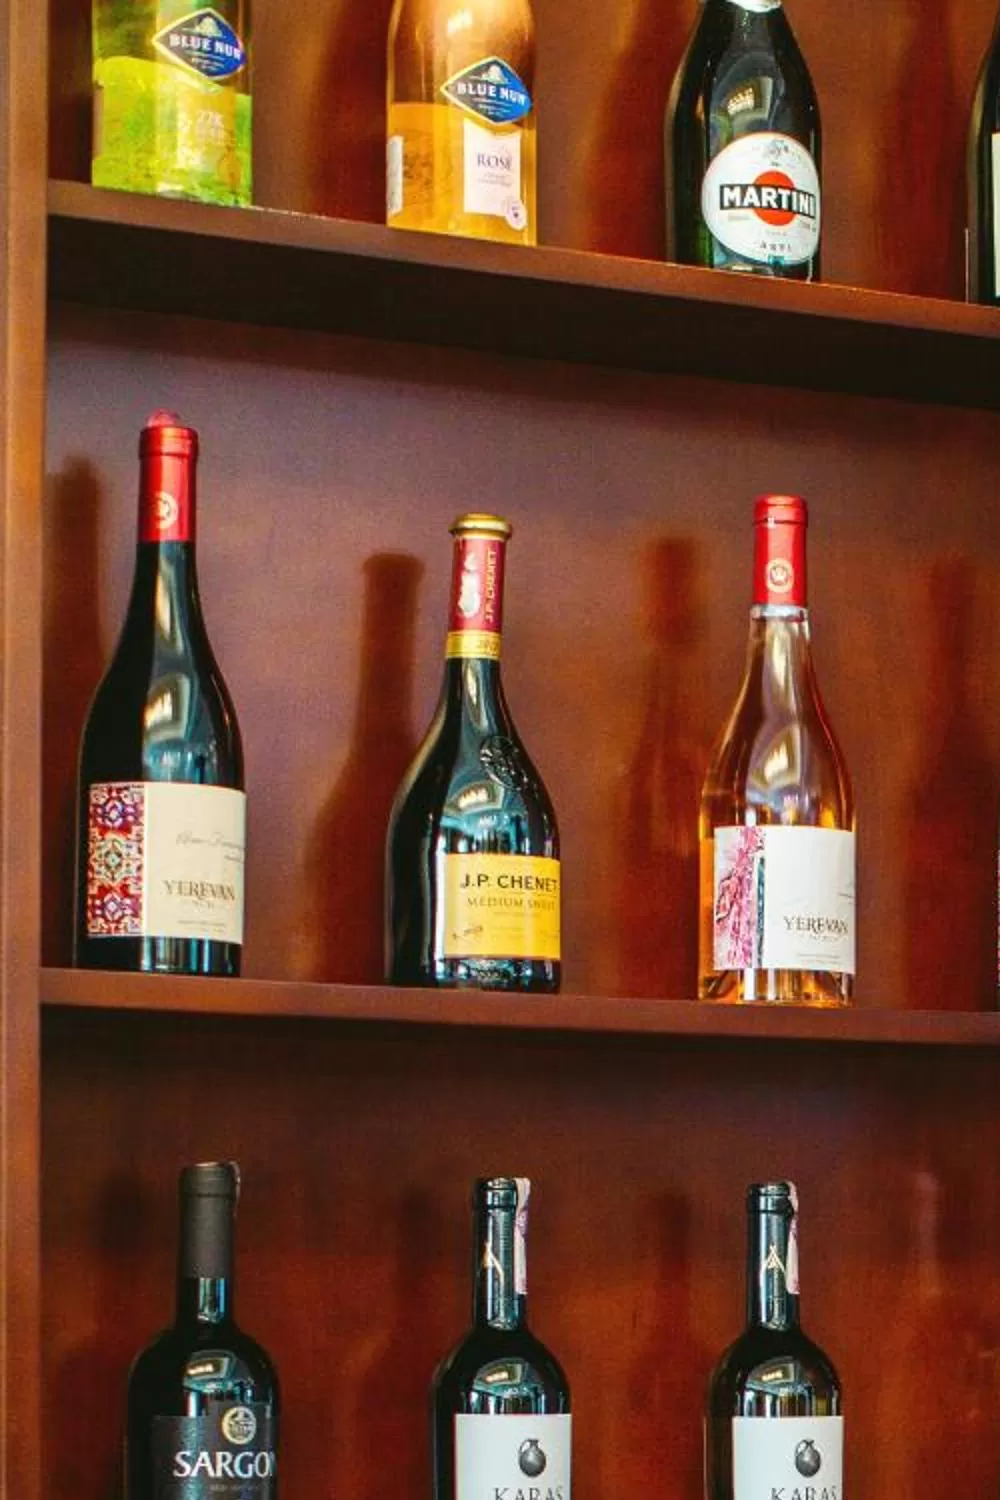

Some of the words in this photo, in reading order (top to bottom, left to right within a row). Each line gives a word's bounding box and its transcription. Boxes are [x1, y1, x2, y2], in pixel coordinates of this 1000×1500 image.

[169, 33, 212, 51] BLUE
[214, 40, 241, 60] NUN
[457, 81, 497, 97] BLUE
[500, 87, 526, 105] NUN
[723, 186, 815, 216] MARTINI
[162, 880, 236, 900] YEREVAN
[497, 874, 557, 893] CHENET
[784, 916, 848, 935] YEREVAN
